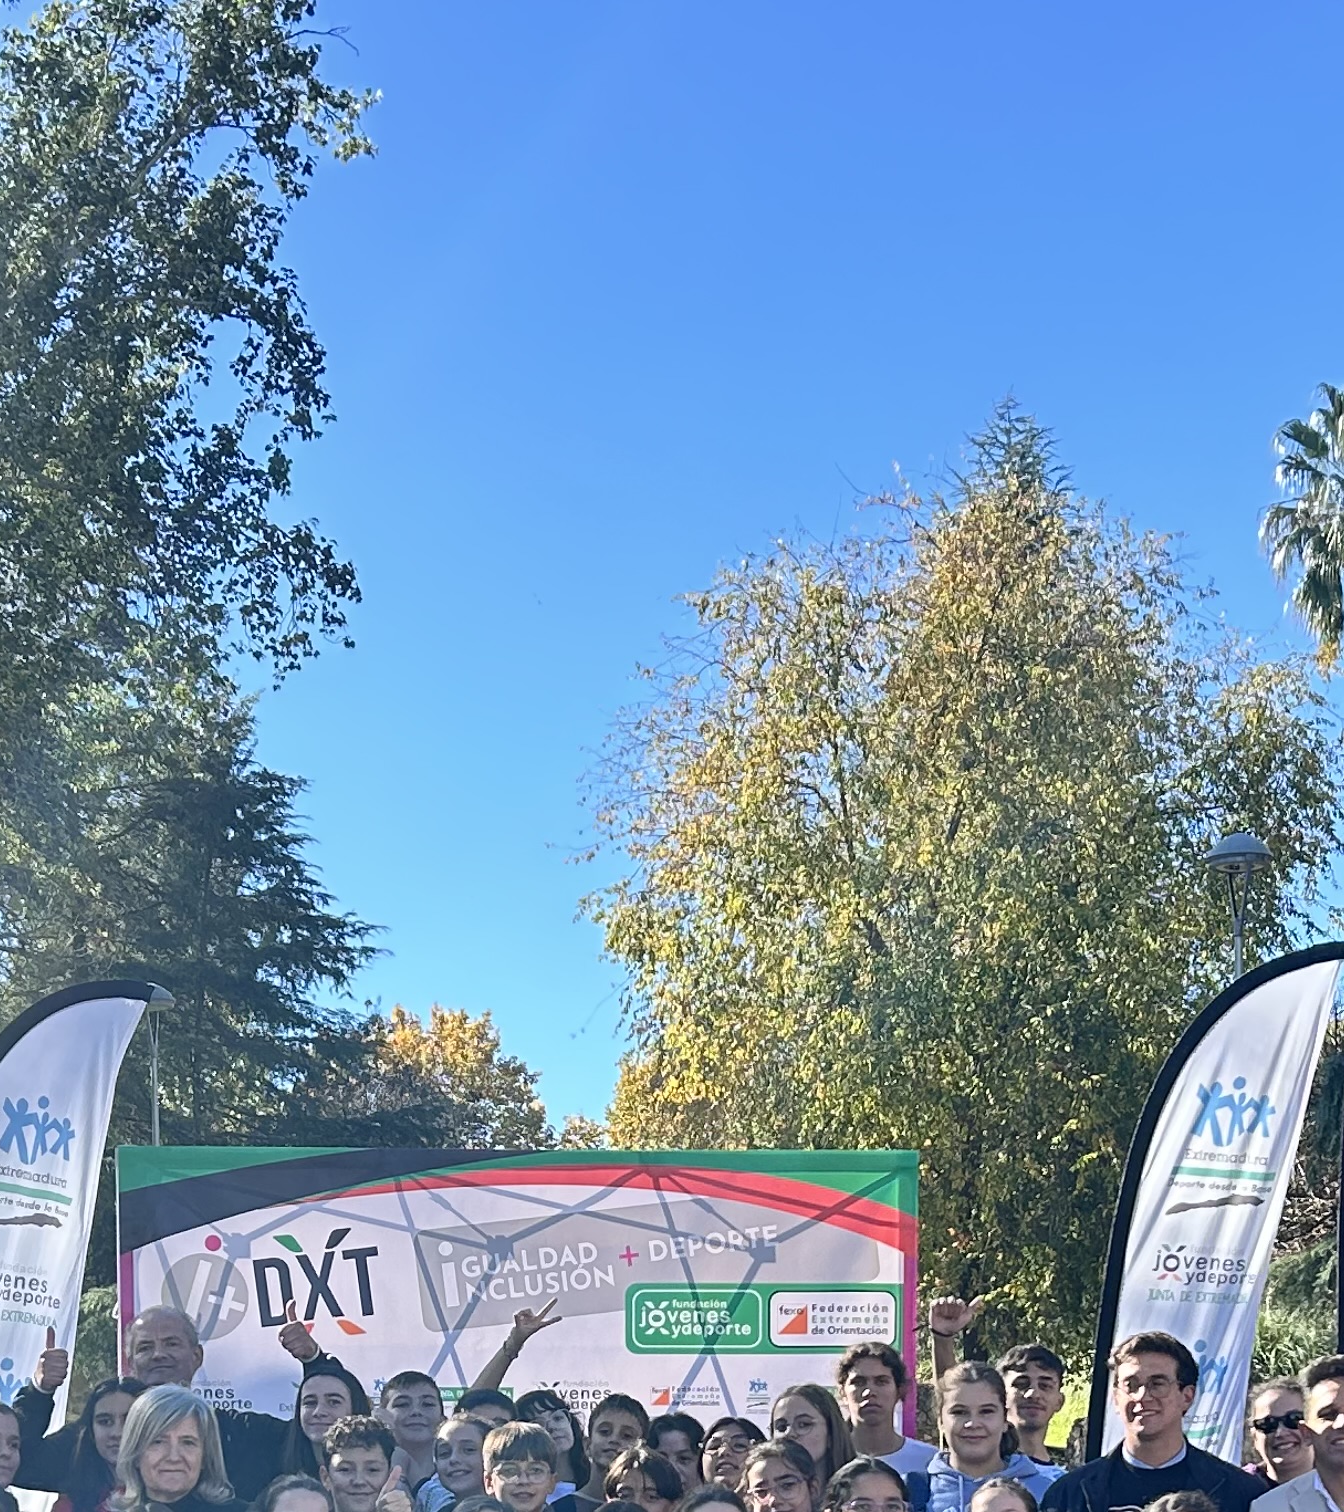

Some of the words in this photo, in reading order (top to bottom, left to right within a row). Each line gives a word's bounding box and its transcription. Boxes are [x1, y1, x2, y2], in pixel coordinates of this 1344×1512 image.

[648, 1224, 778, 1262] DEPORTE
[672, 1299, 728, 1309] fundación
[811, 1303, 889, 1313] Federación
[811, 1314, 889, 1324] Extremeña
[671, 1323, 752, 1339] ydeporte
[811, 1325, 825, 1335] de
[827, 1325, 889, 1335] Orientación
